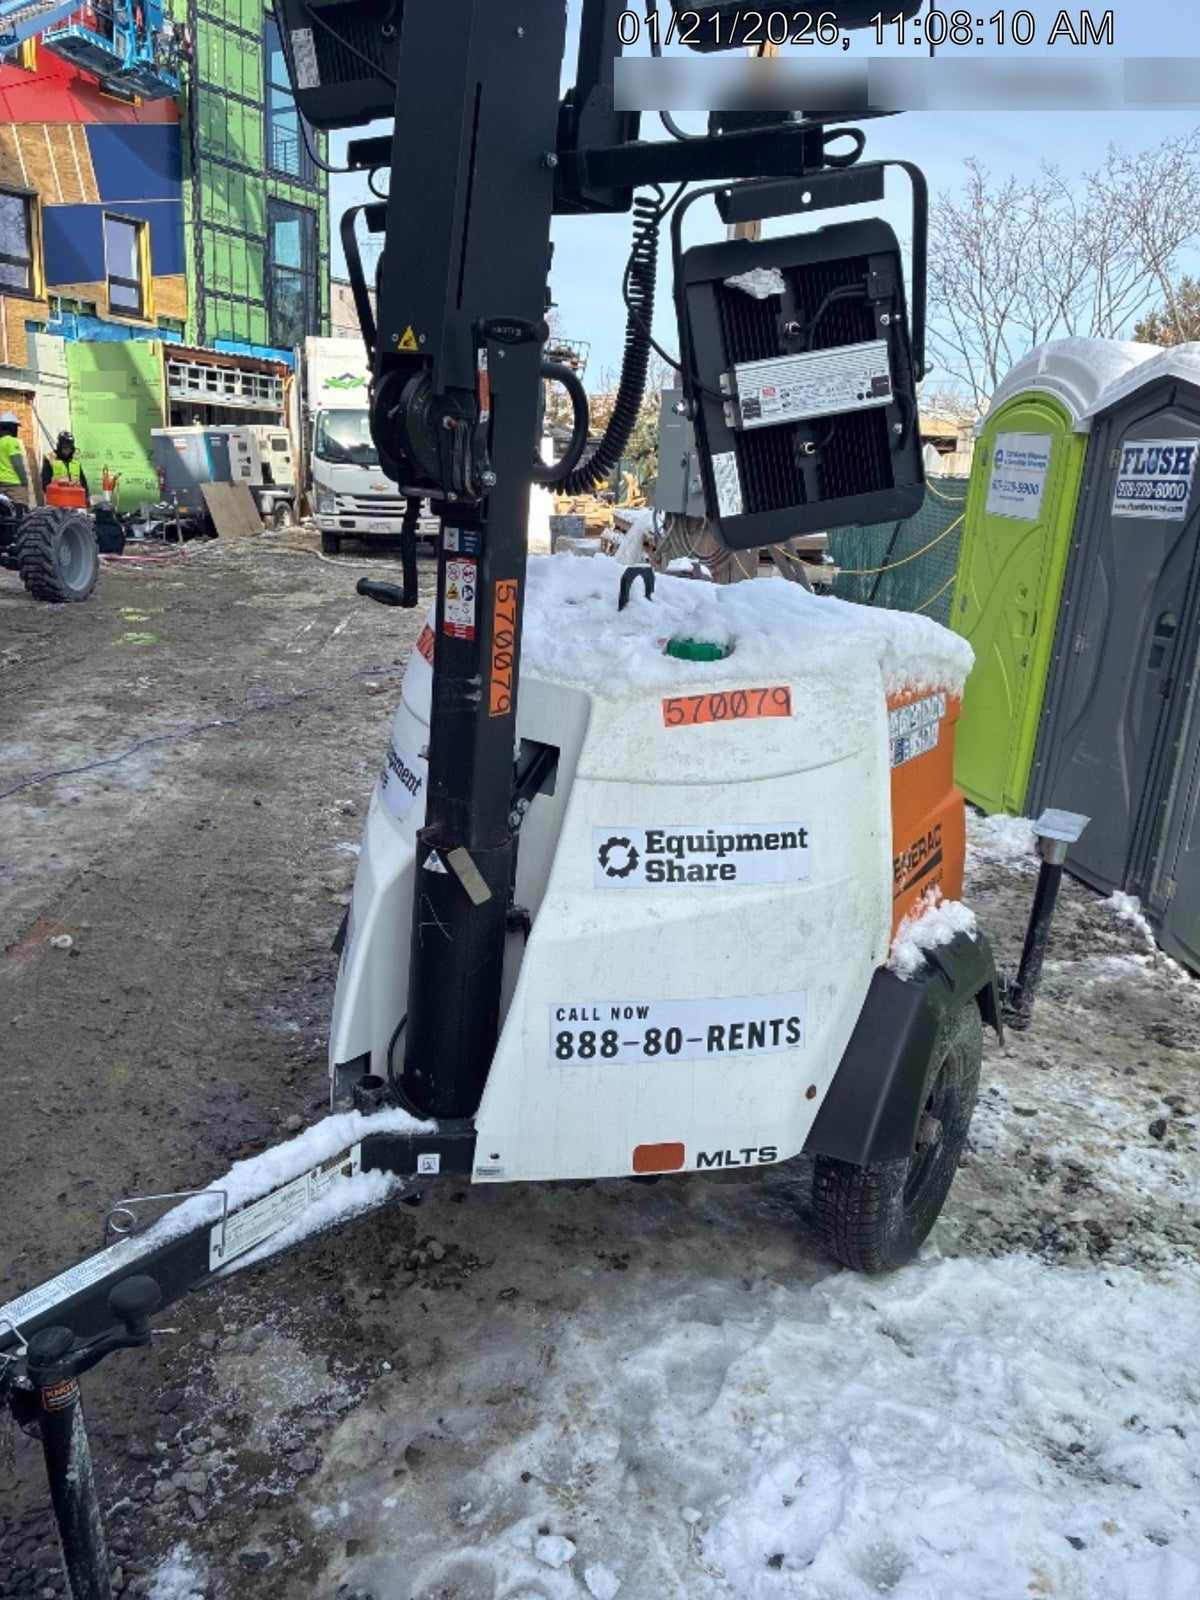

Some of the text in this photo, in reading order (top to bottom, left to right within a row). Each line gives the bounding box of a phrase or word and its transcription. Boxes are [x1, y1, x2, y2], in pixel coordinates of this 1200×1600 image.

[1120, 446, 1195, 475] FLUSH
[490, 583, 517, 715] 570079
[666, 687, 791, 725] 570079
[645, 828, 808, 859] Equipment
[645, 860, 736, 882] Share
[556, 1006, 650, 1022] CALL NOW
[555, 1016, 801, 1060] 888-80-RENTS
[697, 1147, 778, 1168] MLTS
